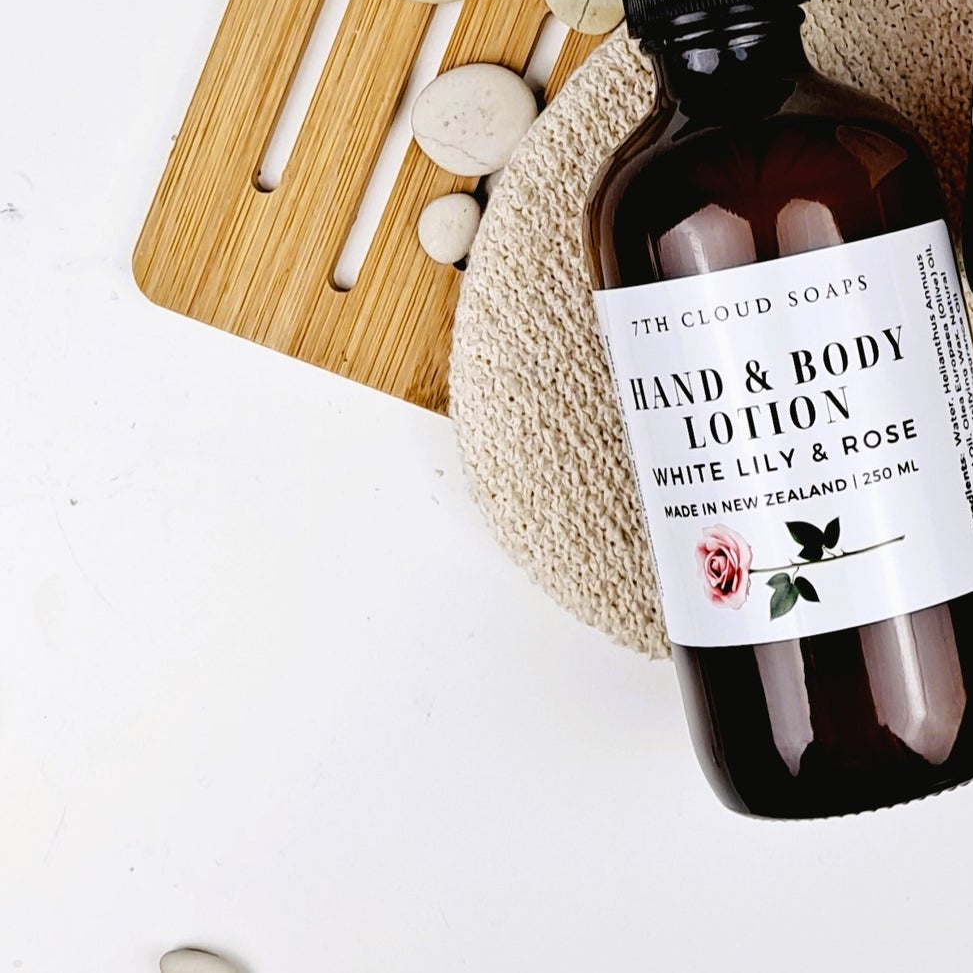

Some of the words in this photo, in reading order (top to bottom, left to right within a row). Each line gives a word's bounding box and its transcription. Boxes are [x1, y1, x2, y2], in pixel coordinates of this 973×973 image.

[631, 315, 670, 336] 7TH
[681, 297, 772, 328] CLOUD
[788, 274, 868, 307] SOAPS
[915, 253, 933, 310] Annuus
[629, 368, 724, 411] HAND
[745, 360, 774, 394] &
[789, 325, 905, 385] BODY
[927, 313, 951, 394] Helianthus
[682, 385, 850, 449] LOTION
[652, 461, 725, 487] WHITE
[736, 447, 795, 477] LILY
[812, 442, 829, 463] &
[841, 418, 918, 456] ROSE
[664, 503, 699, 519] MADE
[701, 501, 718, 516] IN
[721, 496, 758, 514] NEW
[764, 478, 848, 507] ZEALAND
[862, 467, 893, 486] 250
[897, 459, 920, 476] ML
